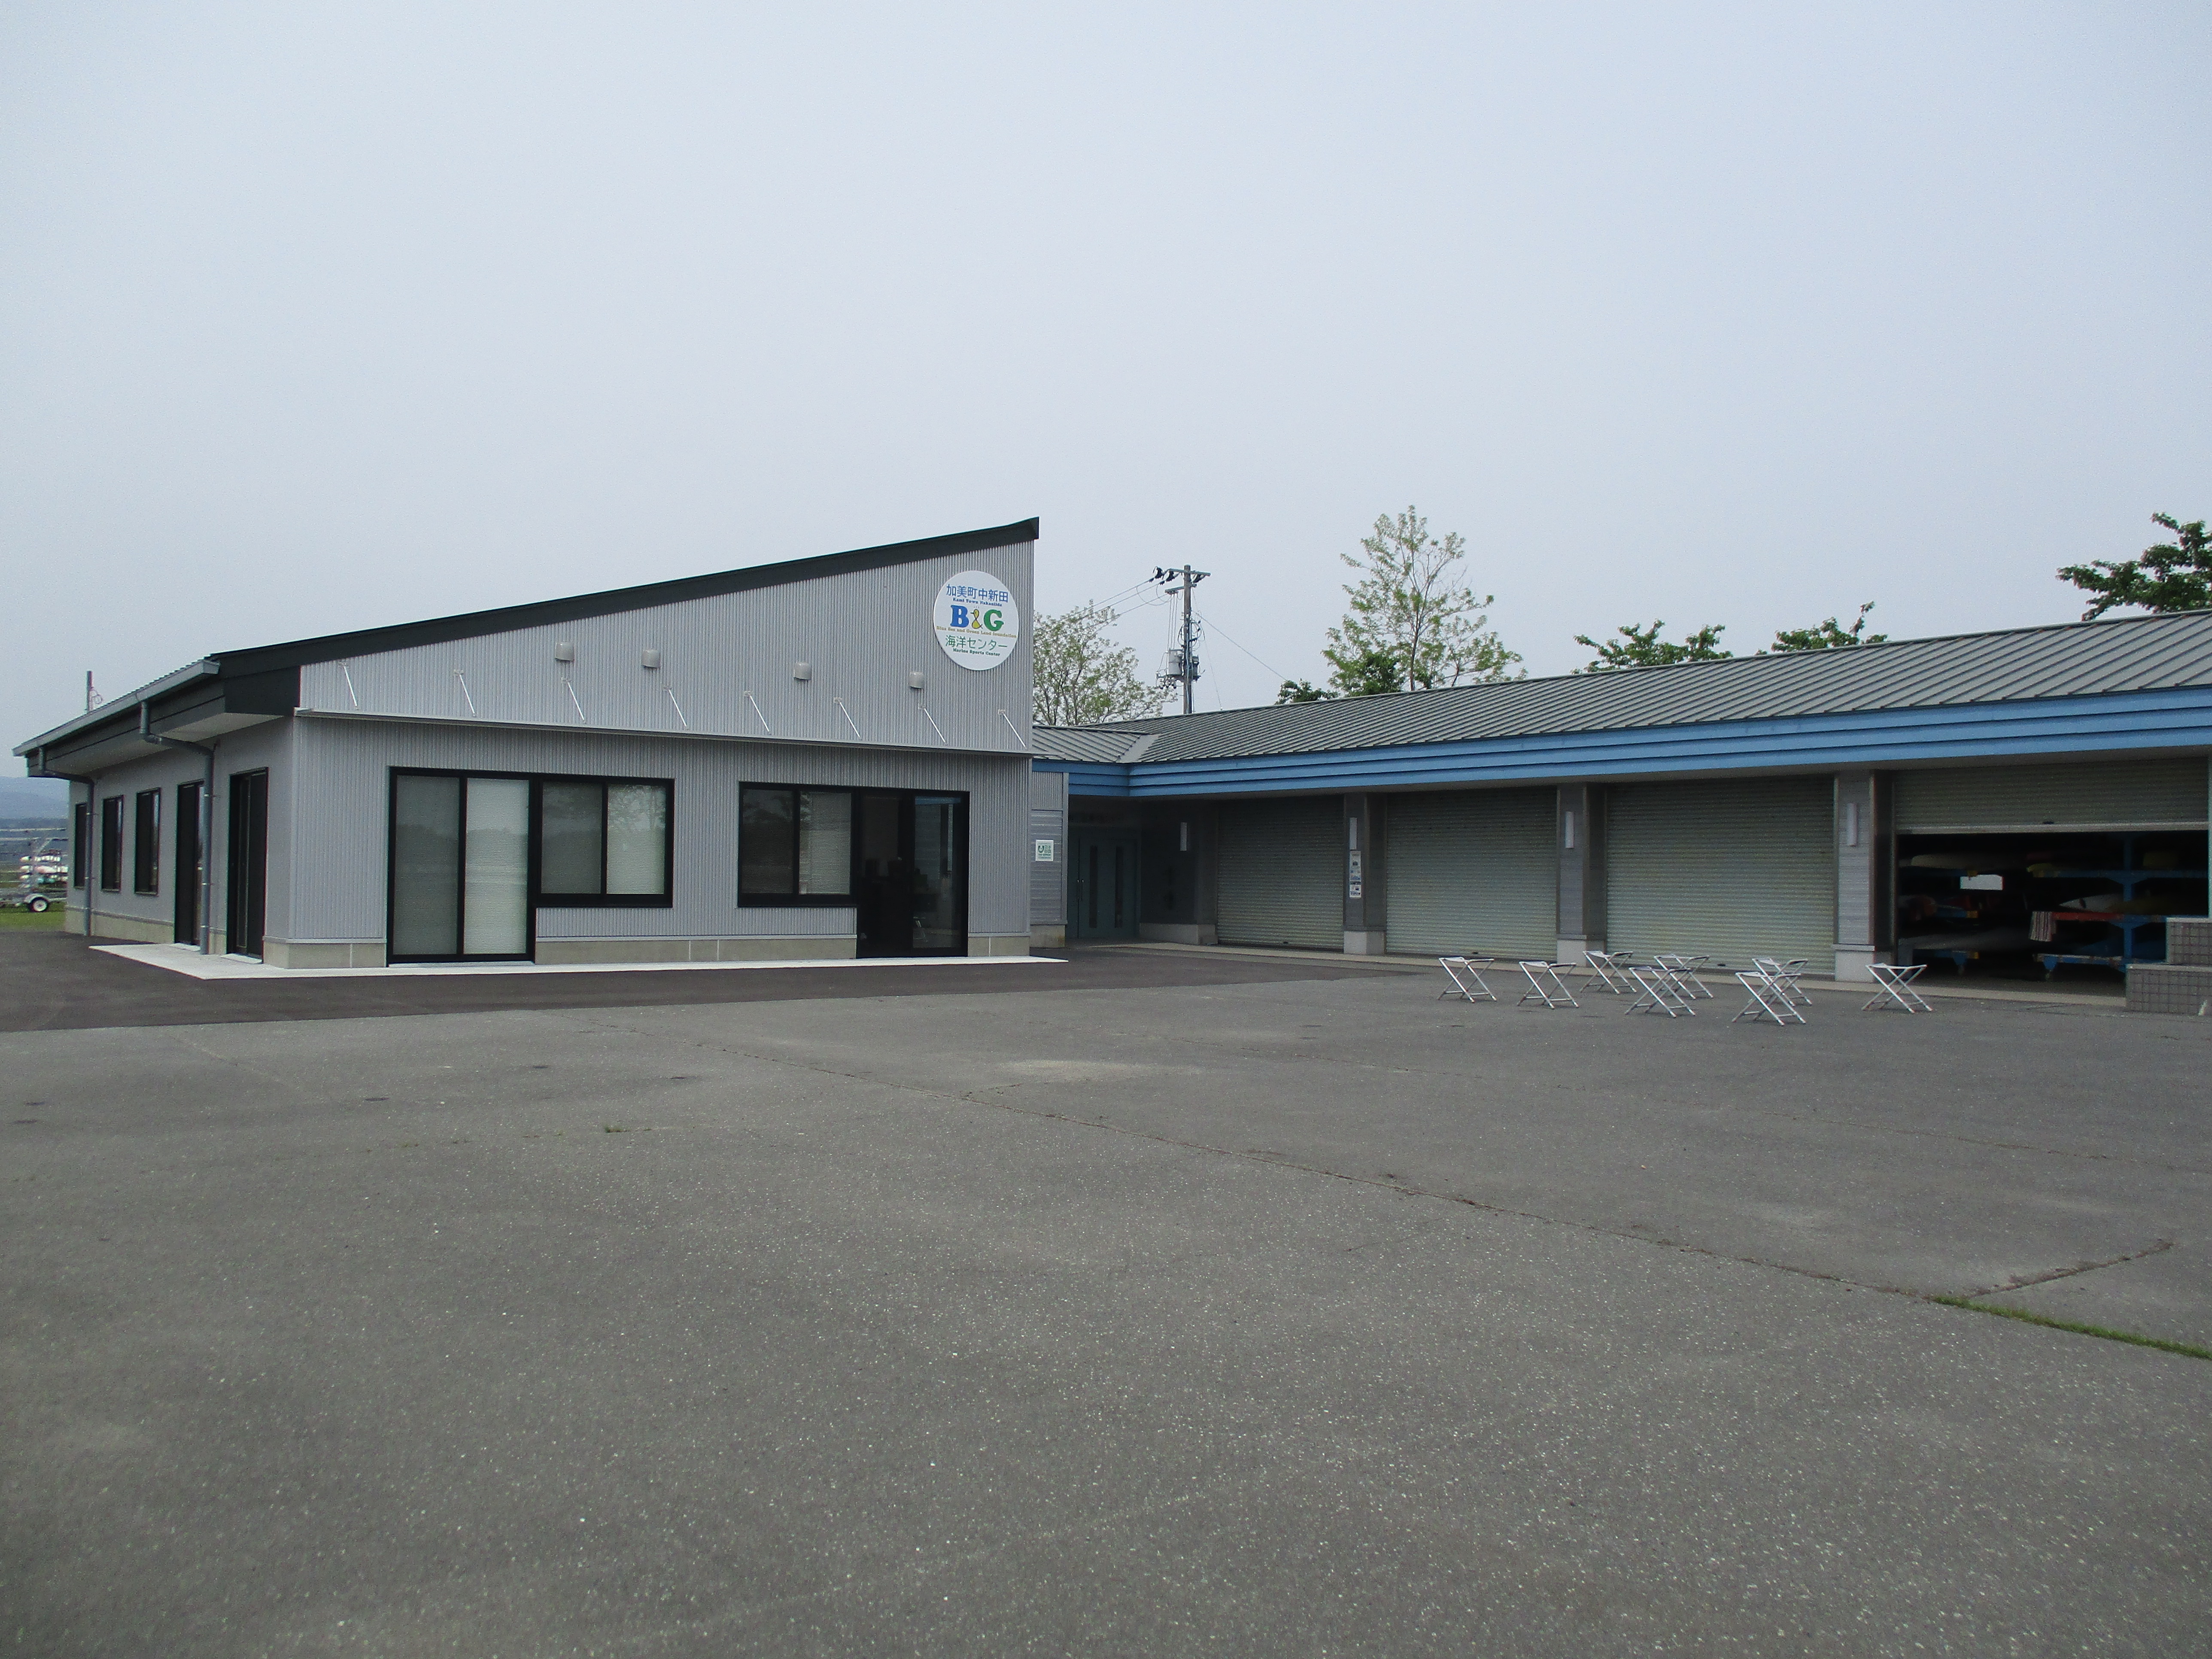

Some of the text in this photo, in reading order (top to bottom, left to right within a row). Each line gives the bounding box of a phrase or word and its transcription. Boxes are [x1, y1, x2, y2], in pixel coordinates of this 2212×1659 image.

[946, 584, 1008, 603] 加美町中新田
[945, 635, 1008, 650] 海洋センター
